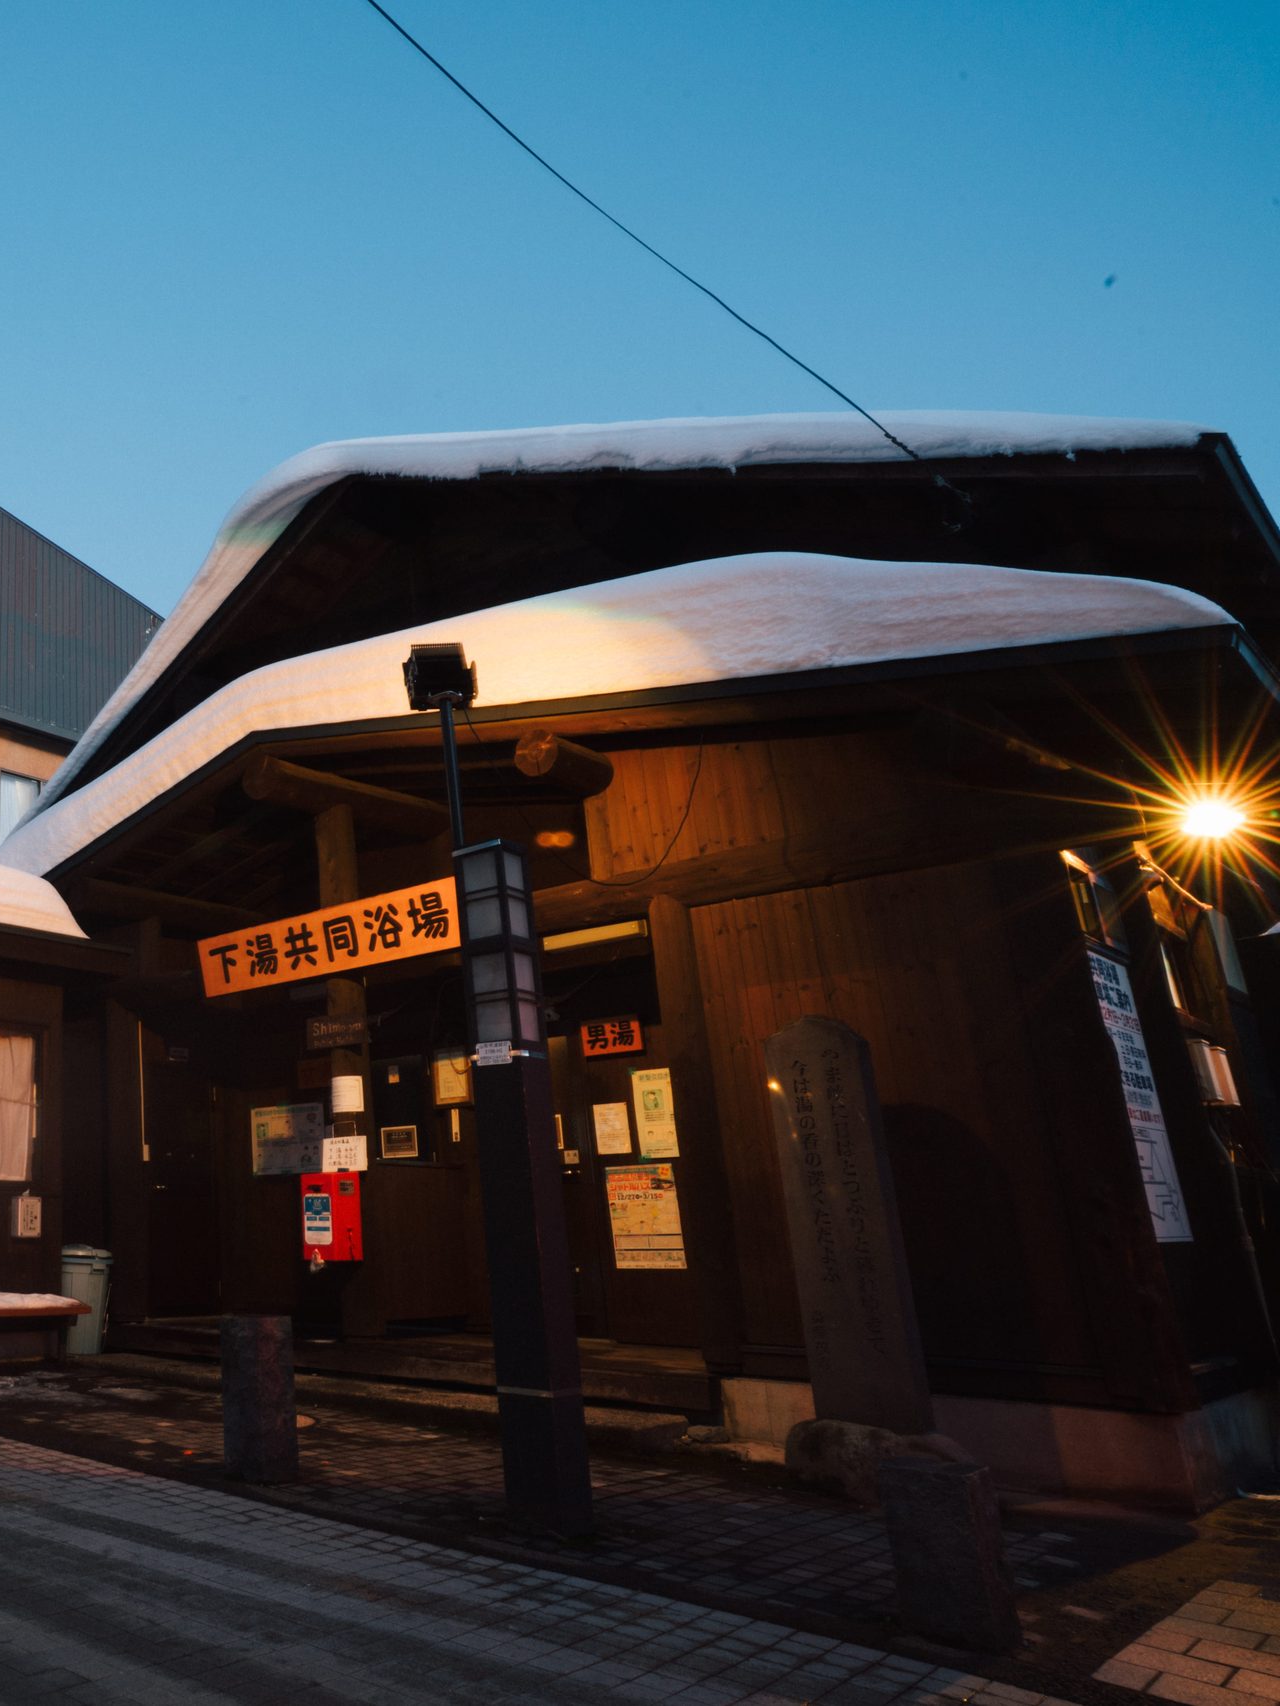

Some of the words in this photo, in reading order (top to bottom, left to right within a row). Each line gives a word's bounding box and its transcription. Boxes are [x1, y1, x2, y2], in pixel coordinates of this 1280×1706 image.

[208, 891, 450, 986] 下湯共同浴場
[587, 1021, 635, 1050] 男湯
